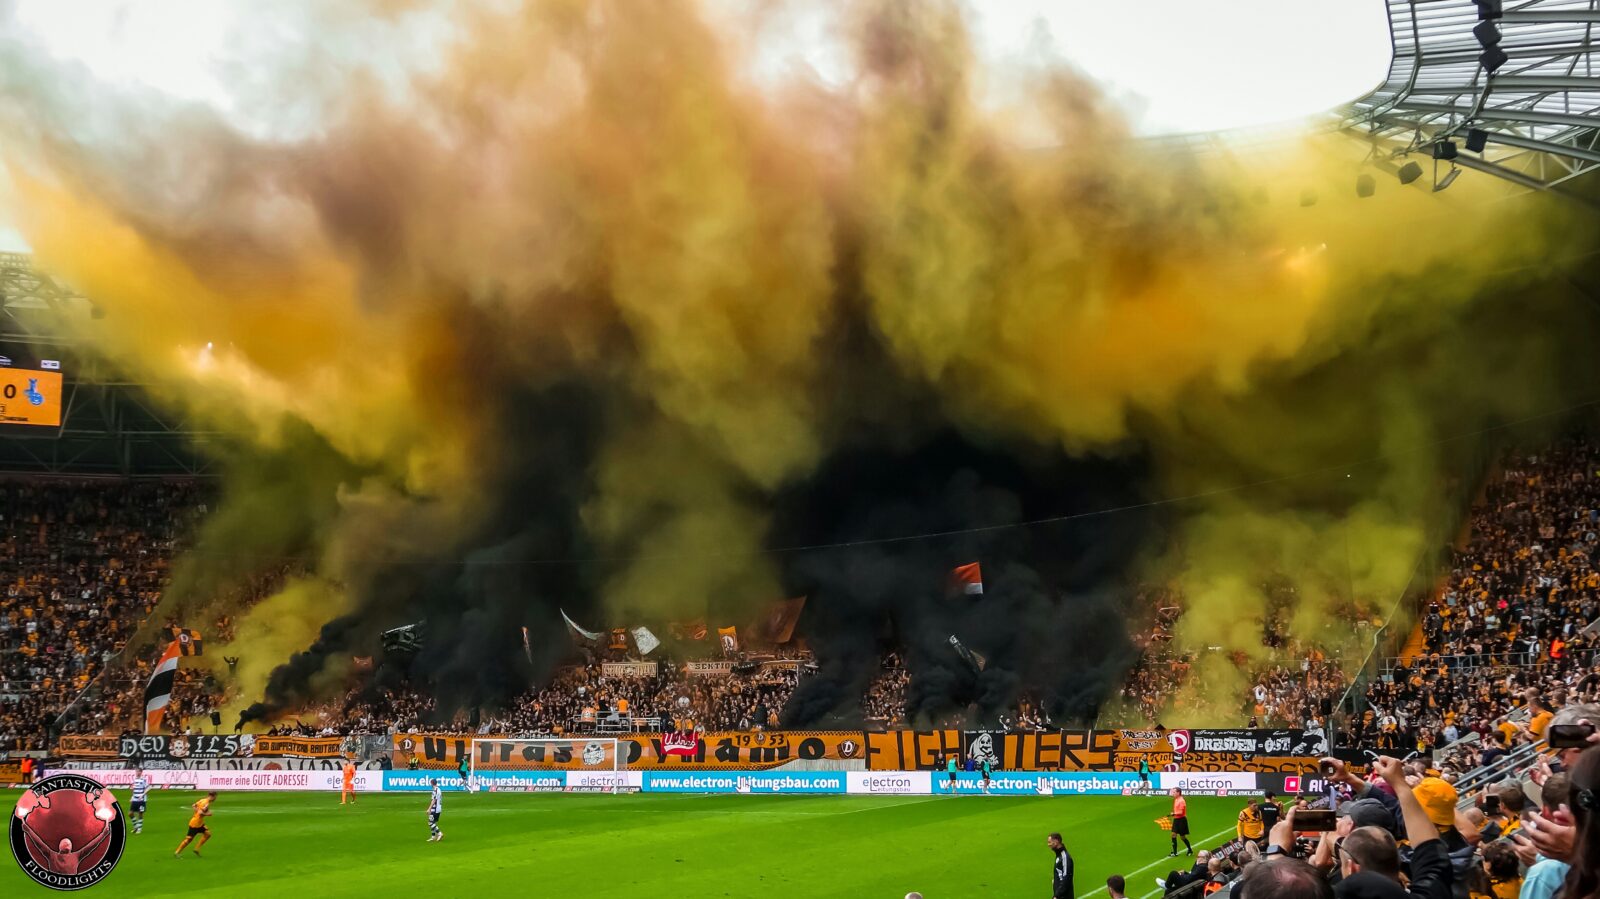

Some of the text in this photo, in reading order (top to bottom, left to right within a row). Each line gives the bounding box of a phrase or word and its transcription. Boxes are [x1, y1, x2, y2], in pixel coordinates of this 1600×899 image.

[736, 734, 784, 746] 19 53
[210, 774, 308, 786] immer eine GUTE ADRESSE!
[651, 775, 839, 790] www.electron-litungsbau.com
[939, 777, 1152, 793] www.eectron-litungsbau.com
[1178, 778, 1232, 789] electron
